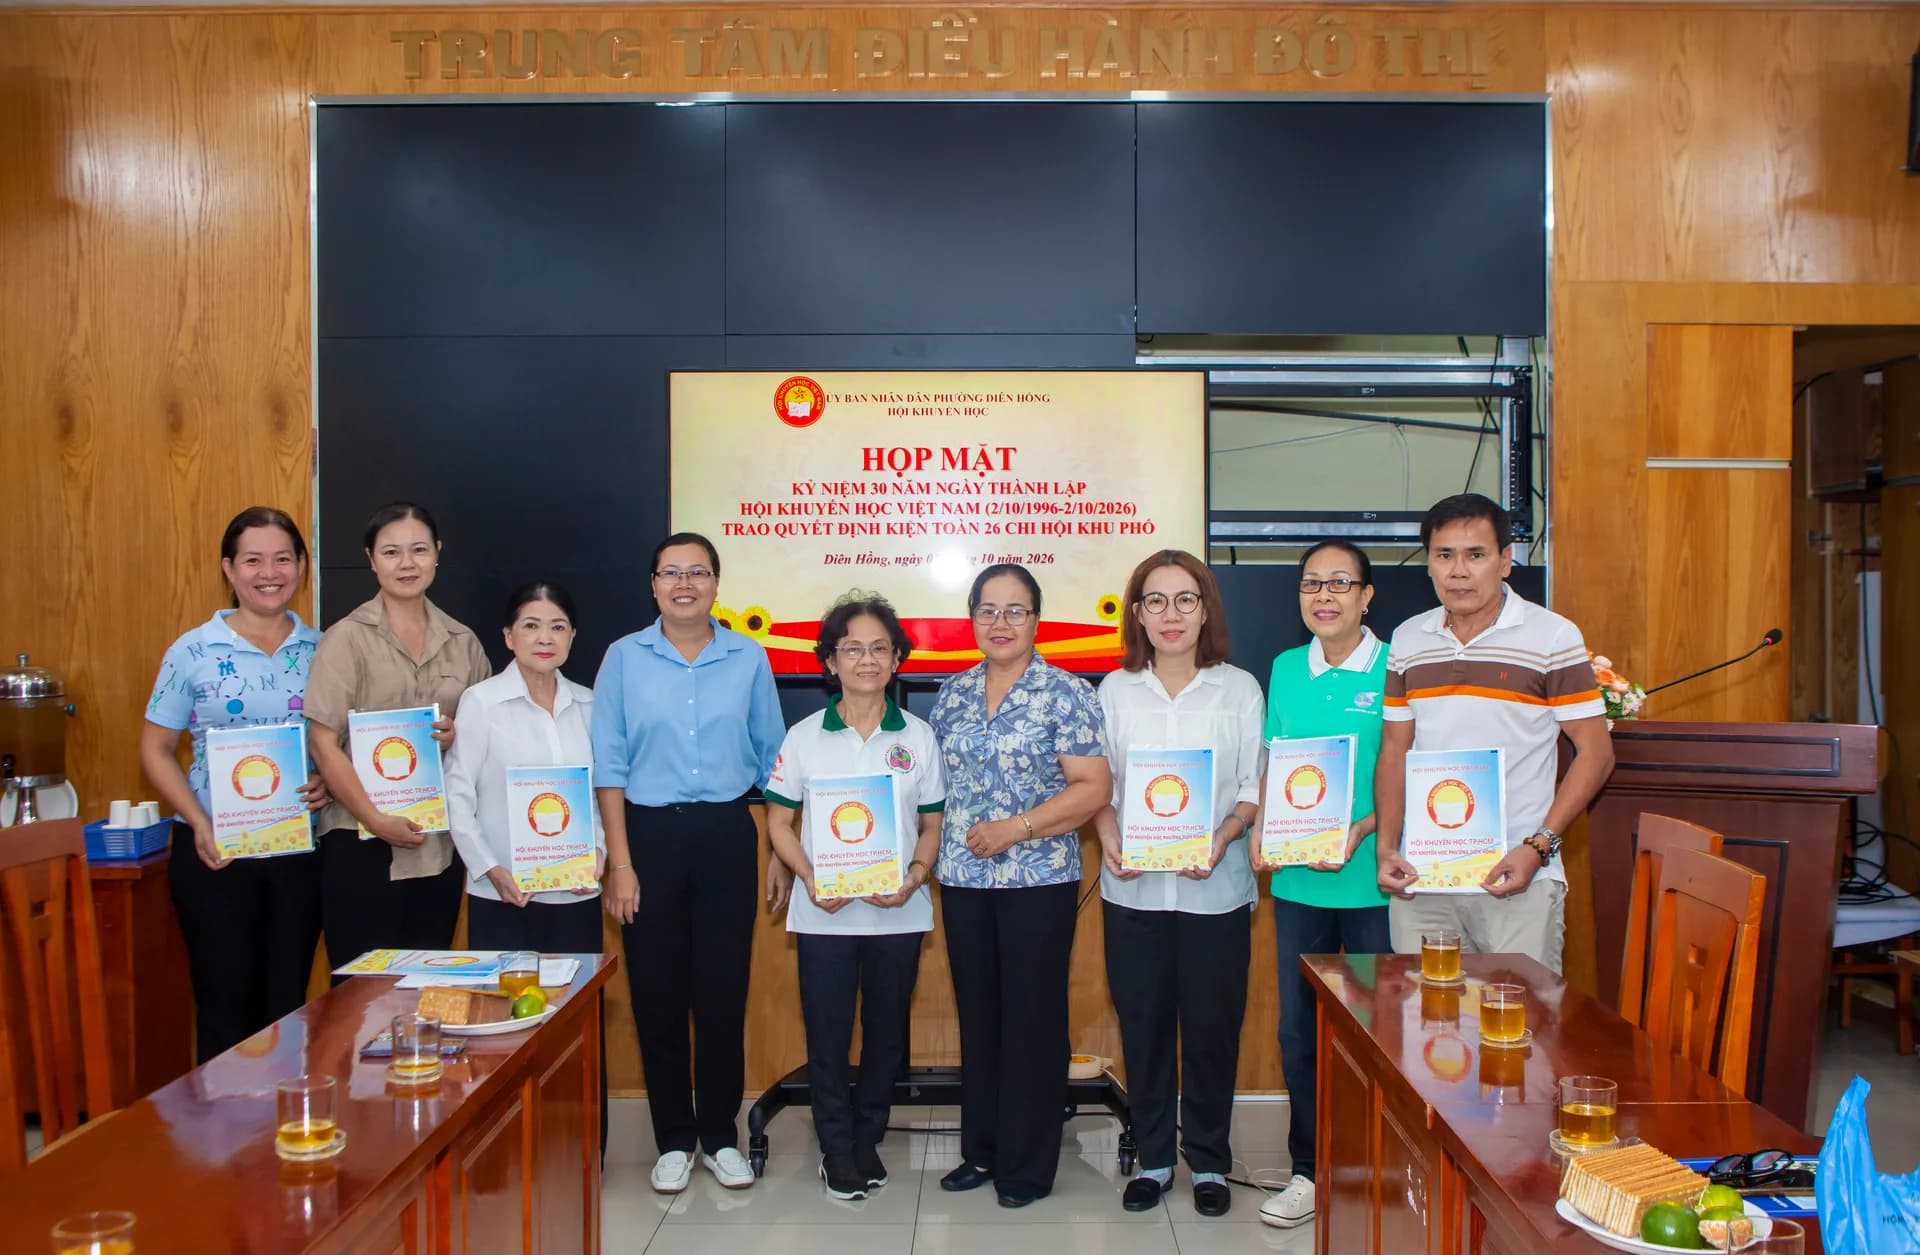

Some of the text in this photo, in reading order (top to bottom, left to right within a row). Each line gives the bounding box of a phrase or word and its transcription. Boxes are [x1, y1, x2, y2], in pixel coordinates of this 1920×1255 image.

[390, 9, 1489, 88] TRUNG TÂM ĐIỀU HÀNH ĐÔ THỊ
[845, 393, 868, 403] BAN
[870, 391, 903, 403] NHÂN
[906, 391, 931, 403] DÂN
[934, 391, 983, 403] PHƯỜNG
[1017, 391, 1051, 404] HỒNG
[887, 406, 909, 418] HỘI
[964, 406, 989, 418] HỌC
[861, 443, 1017, 478] HỌP MẶT
[792, 478, 1087, 498] KỶ NIỆM 30 NĂM NGÀY THÀNH LẬP
[740, 499, 1137, 519] HỘI KHUYẾN HỌC VIỆT NAM (2/10/1996-2/10/2026)
[722, 518, 1156, 539] TRAO QUYẾT ĐỊNH KIỆN TOÀN 26 CHI HỘI KHU PHỐ
[824, 553, 851, 565] Diên
[855, 550, 891, 567] Hồng,
[894, 553, 923, 567] ngày
[981, 553, 995, 564] 10
[997, 553, 1023, 564] năm
[1027, 552, 1055, 564] 2026
